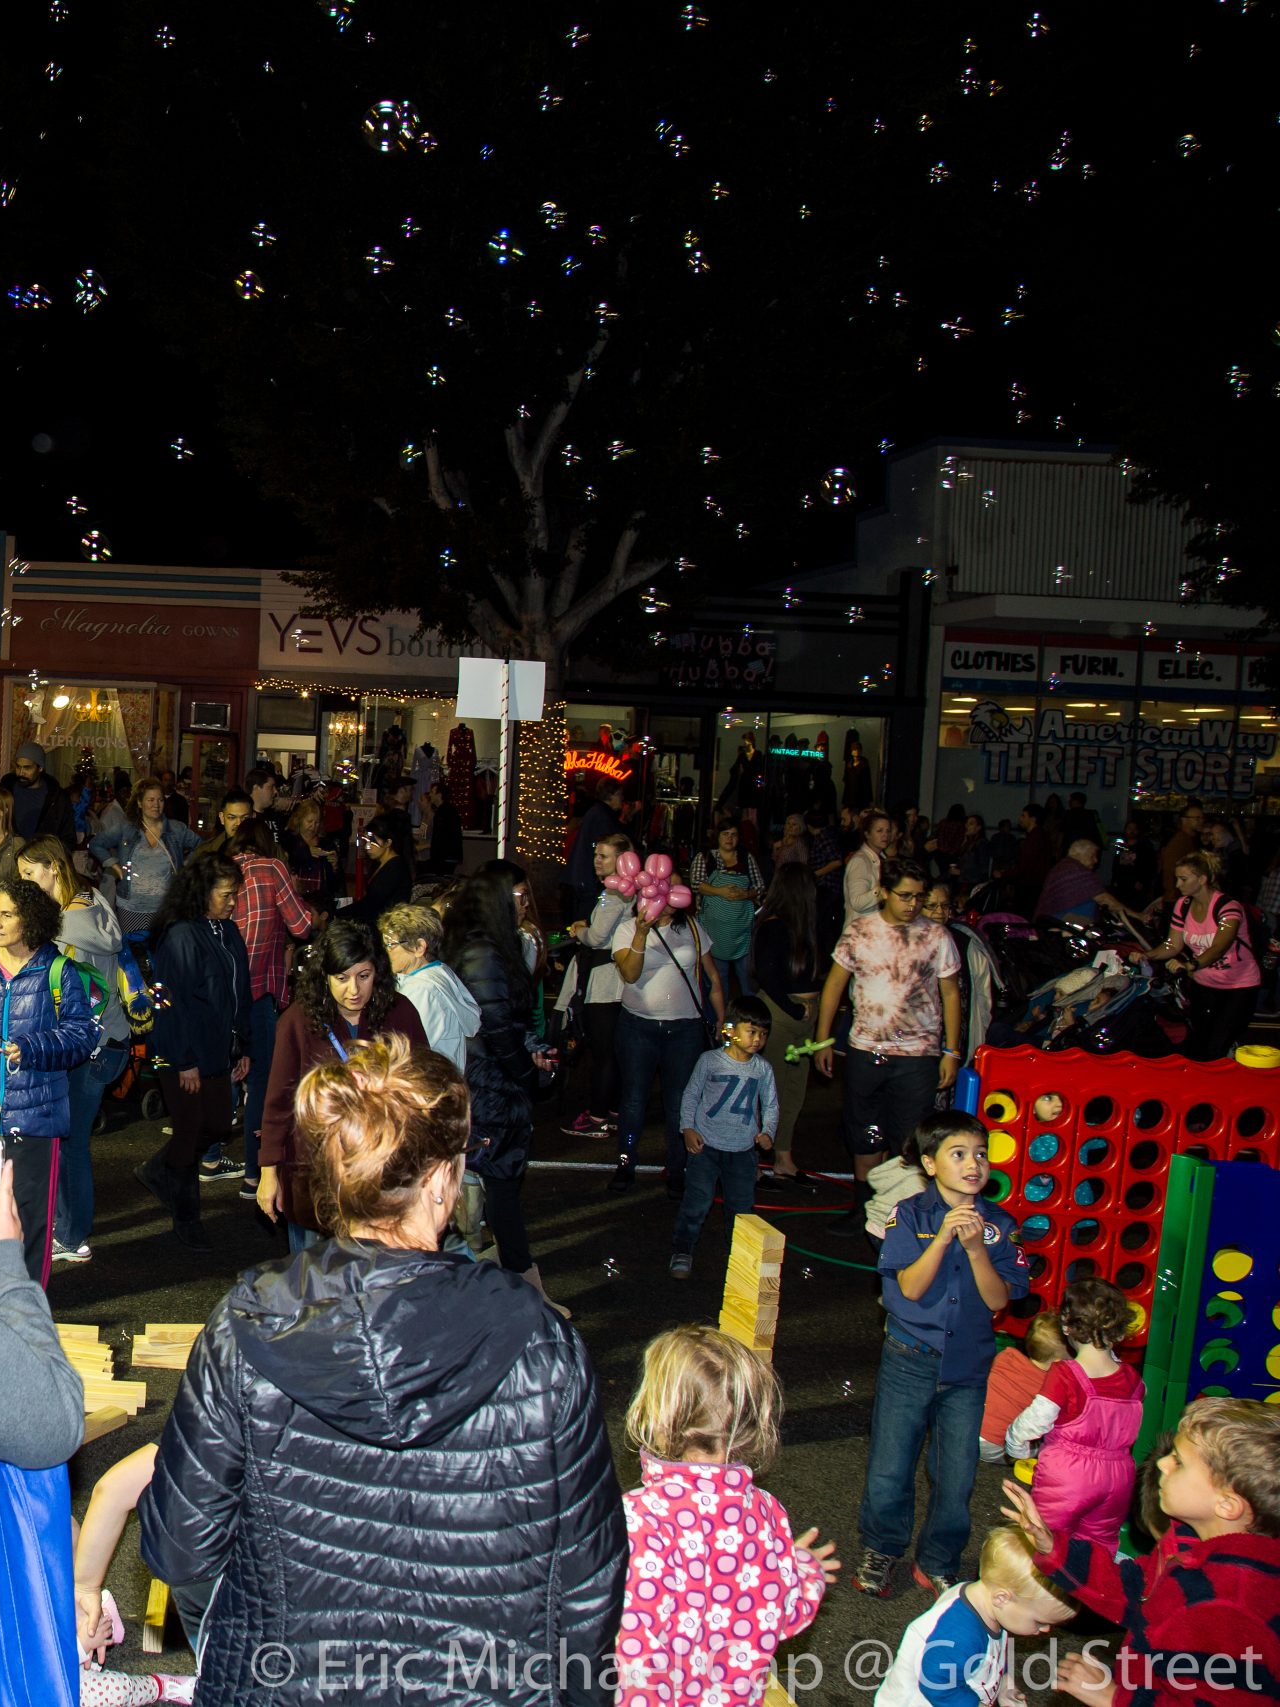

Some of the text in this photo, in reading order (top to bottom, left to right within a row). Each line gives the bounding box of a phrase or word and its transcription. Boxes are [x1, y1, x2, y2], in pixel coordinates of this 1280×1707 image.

[40, 607, 240, 642] Magnolia GOWNS
[269, 613, 381, 655] YEVS
[951, 650, 1036, 672] CLOTHES
[1060, 654, 1124, 677] FURN.
[1158, 659, 1221, 681] ELEC.
[771, 748, 825, 759] VINTAGE ATTIRE
[984, 743, 1253, 794] THRIFT STORE
[706, 1075, 759, 1126] 74
